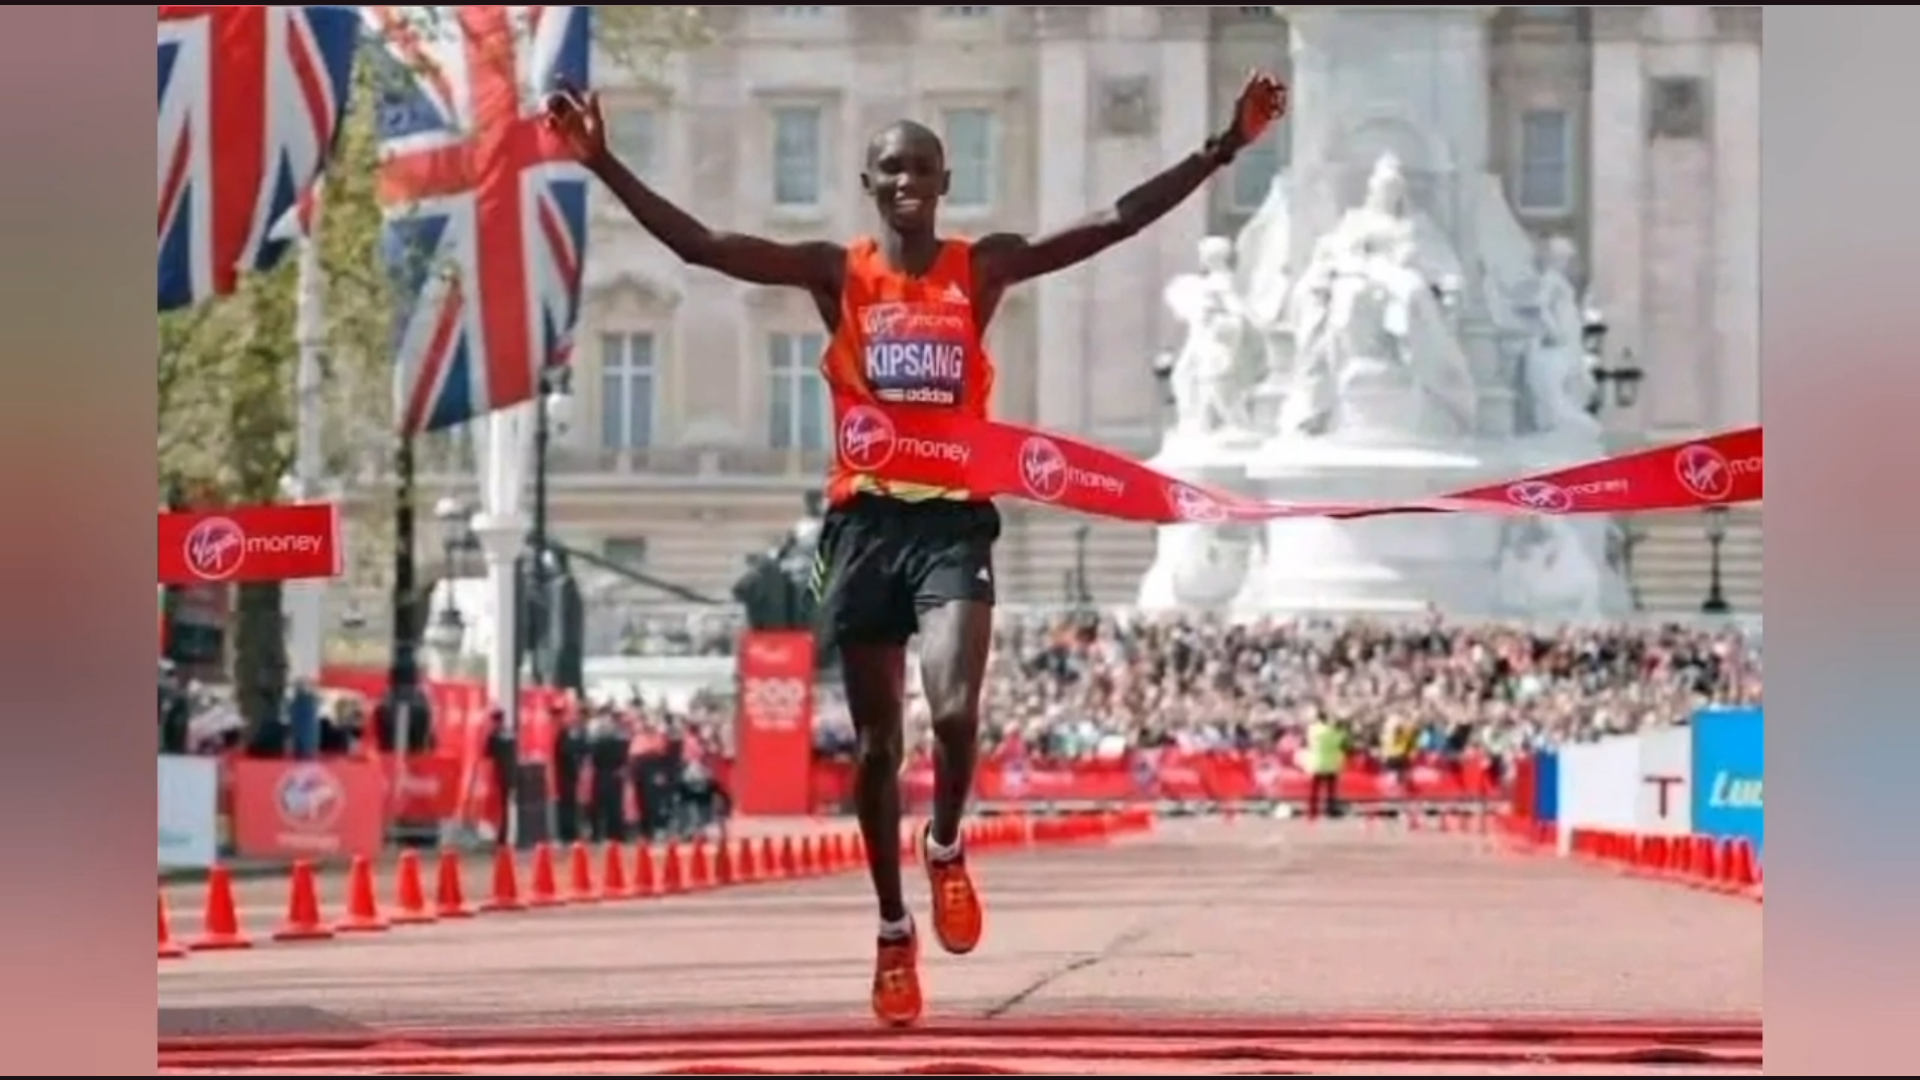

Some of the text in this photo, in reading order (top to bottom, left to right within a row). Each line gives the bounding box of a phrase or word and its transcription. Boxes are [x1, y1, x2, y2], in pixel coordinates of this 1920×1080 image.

[865, 343, 964, 379] KIPSANG
[905, 387, 954, 404] adidas
[845, 415, 971, 469] Virgin money
[1066, 465, 1125, 497] money
[191, 525, 323, 570] Virgin money
